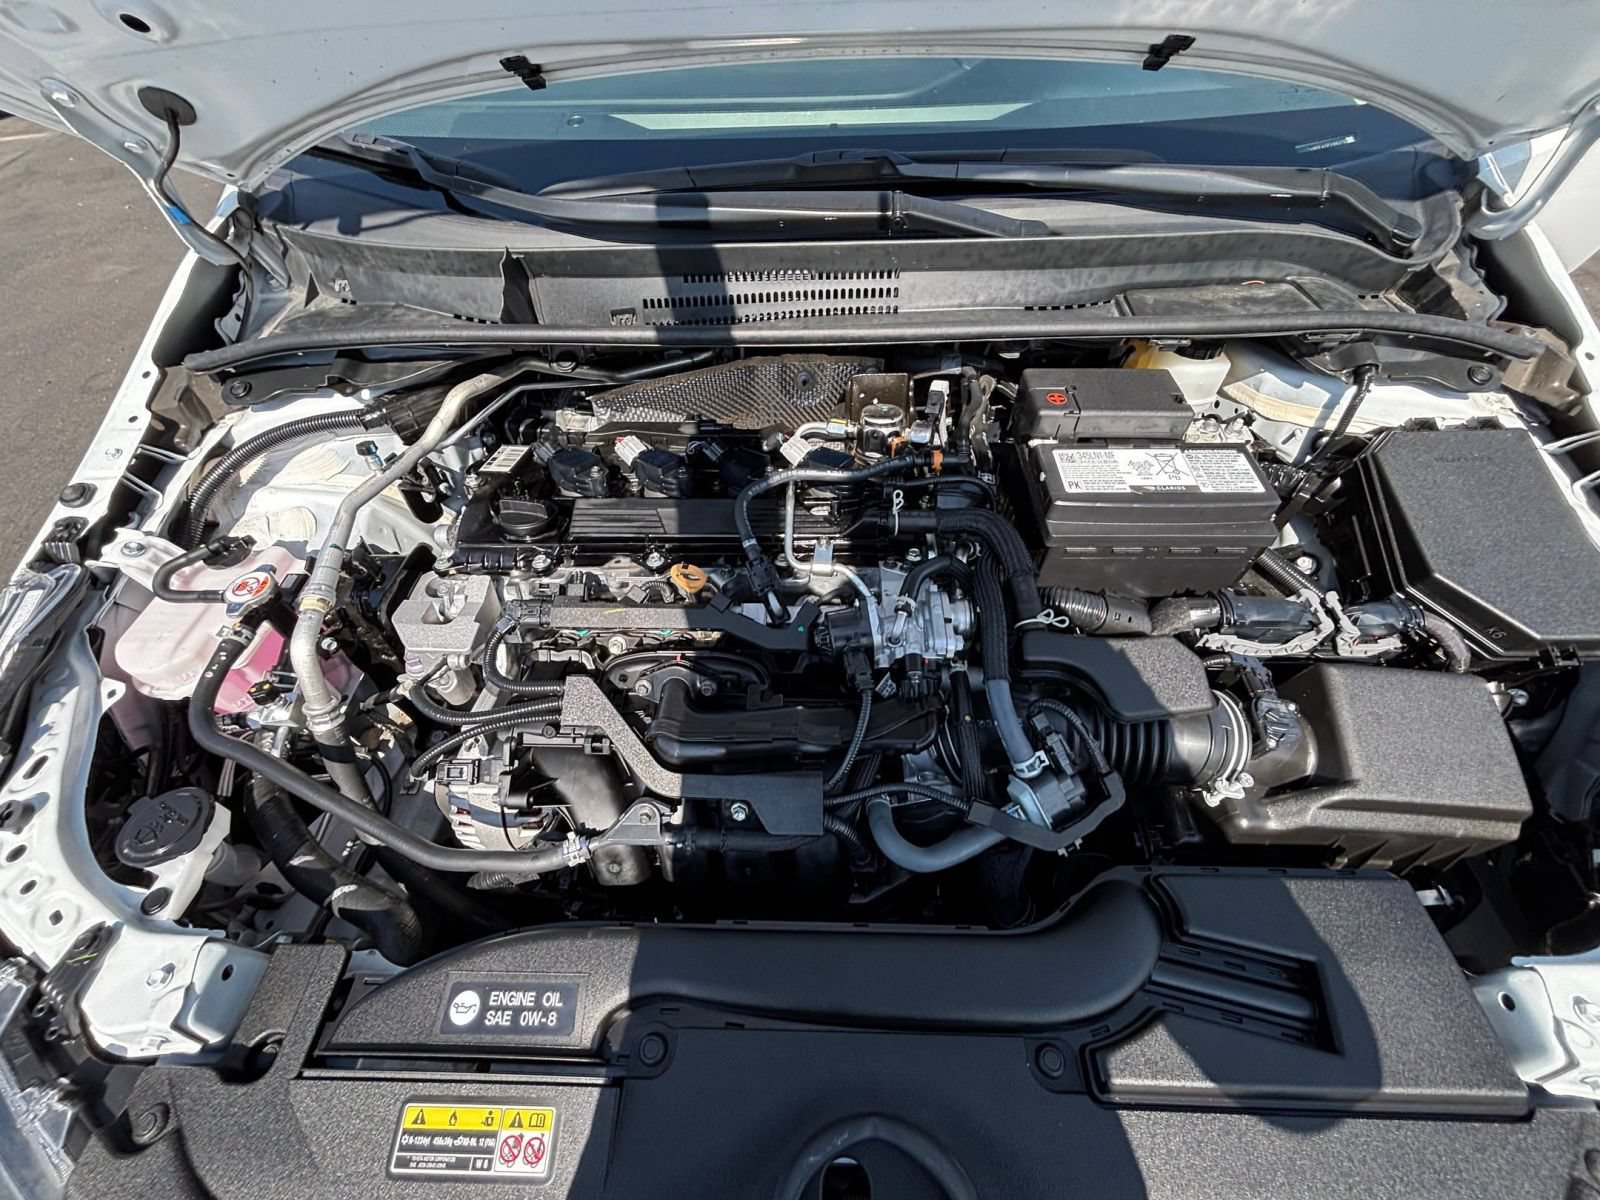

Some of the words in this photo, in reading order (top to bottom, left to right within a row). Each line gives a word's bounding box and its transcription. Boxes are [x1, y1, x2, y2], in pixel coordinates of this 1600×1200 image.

[1067, 481, 1082, 490] PK
[489, 991, 537, 1006] ENGINE
[542, 992, 564, 1007] OIL
[484, 1010, 512, 1026] SAE
[520, 1011, 557, 1026] 0W-8
